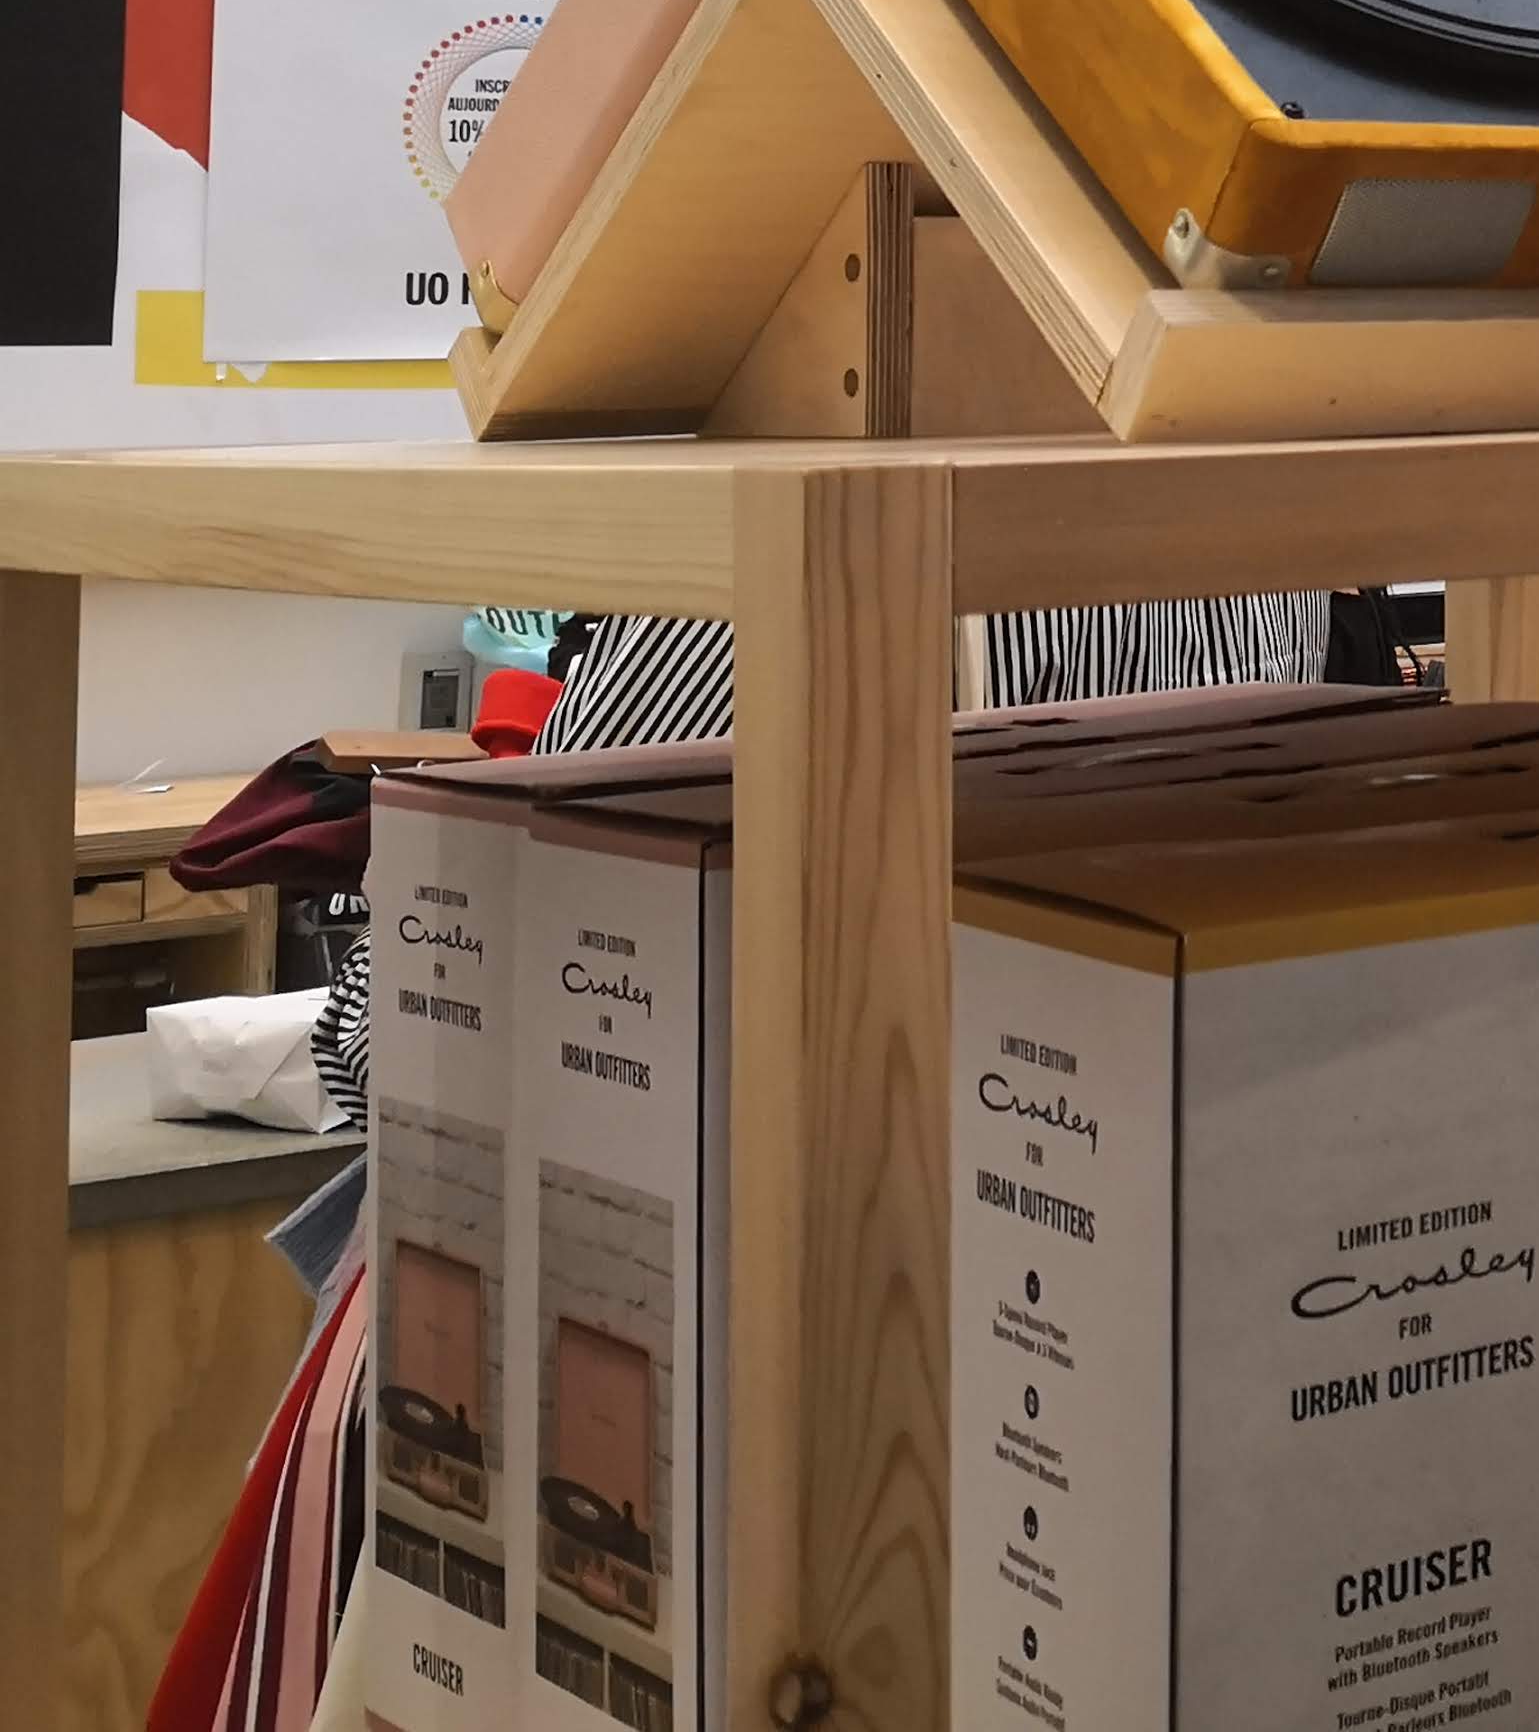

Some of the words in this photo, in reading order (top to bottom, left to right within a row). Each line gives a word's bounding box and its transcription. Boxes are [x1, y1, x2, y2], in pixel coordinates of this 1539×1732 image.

[405, 272, 449, 305] UO
[399, 915, 483, 966] Crosley
[561, 962, 652, 1019] Crosley
[595, 1050, 651, 1091] OUTFITTERS
[978, 1072, 1098, 1156] Crosley
[977, 1168, 1016, 1214] URBAN
[1020, 1185, 1096, 1245] OUTFITTERS
[1337, 1215, 1413, 1252] LIMITED
[1419, 1200, 1492, 1236] EDITION
[1290, 1245, 1536, 1319] Crosley
[1398, 1313, 1433, 1340] FOR
[1291, 1370, 1378, 1422] URBAN
[1387, 1336, 1535, 1400] OUTFITTERS
[1335, 1538, 1492, 1618] CRUISER
[1327, 1668, 1358, 1692] with
[1362, 1647, 1430, 1683] Bluetooth
[1434, 1629, 1499, 1661] Speakers
[1335, 1633, 1395, 1663] Portable
[1397, 1616, 1446, 1646] Record
[1449, 1606, 1492, 1630] Player
[413, 1643, 464, 1697] CRUISER
